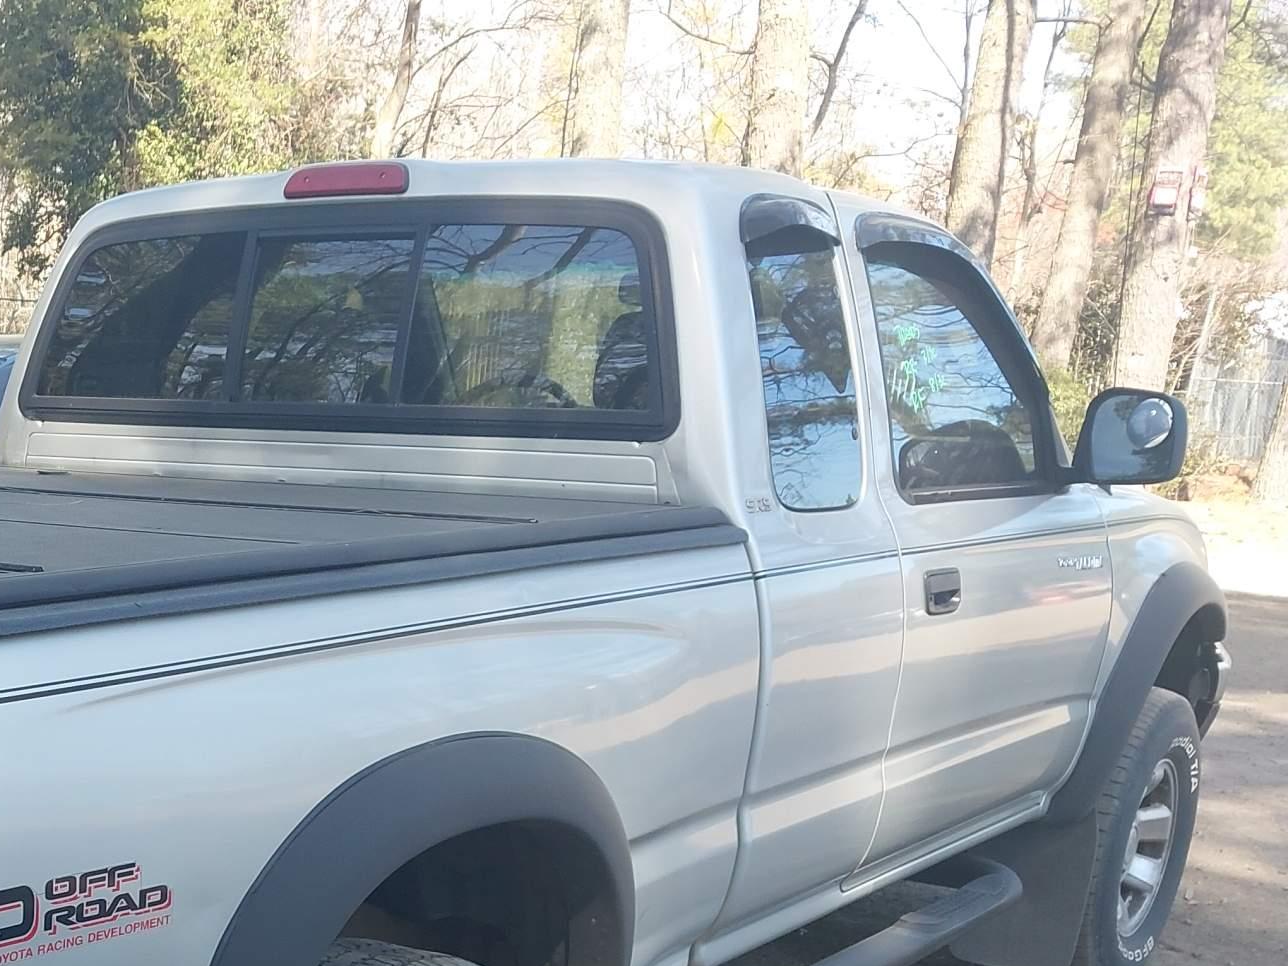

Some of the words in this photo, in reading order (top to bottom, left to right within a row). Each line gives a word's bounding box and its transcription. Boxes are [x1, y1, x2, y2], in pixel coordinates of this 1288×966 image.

[44, 861, 141, 904] OFF
[43, 884, 173, 936] ROAD
[37, 935, 84, 956] RACING
[87, 914, 172, 944] DEVELOPMENT
